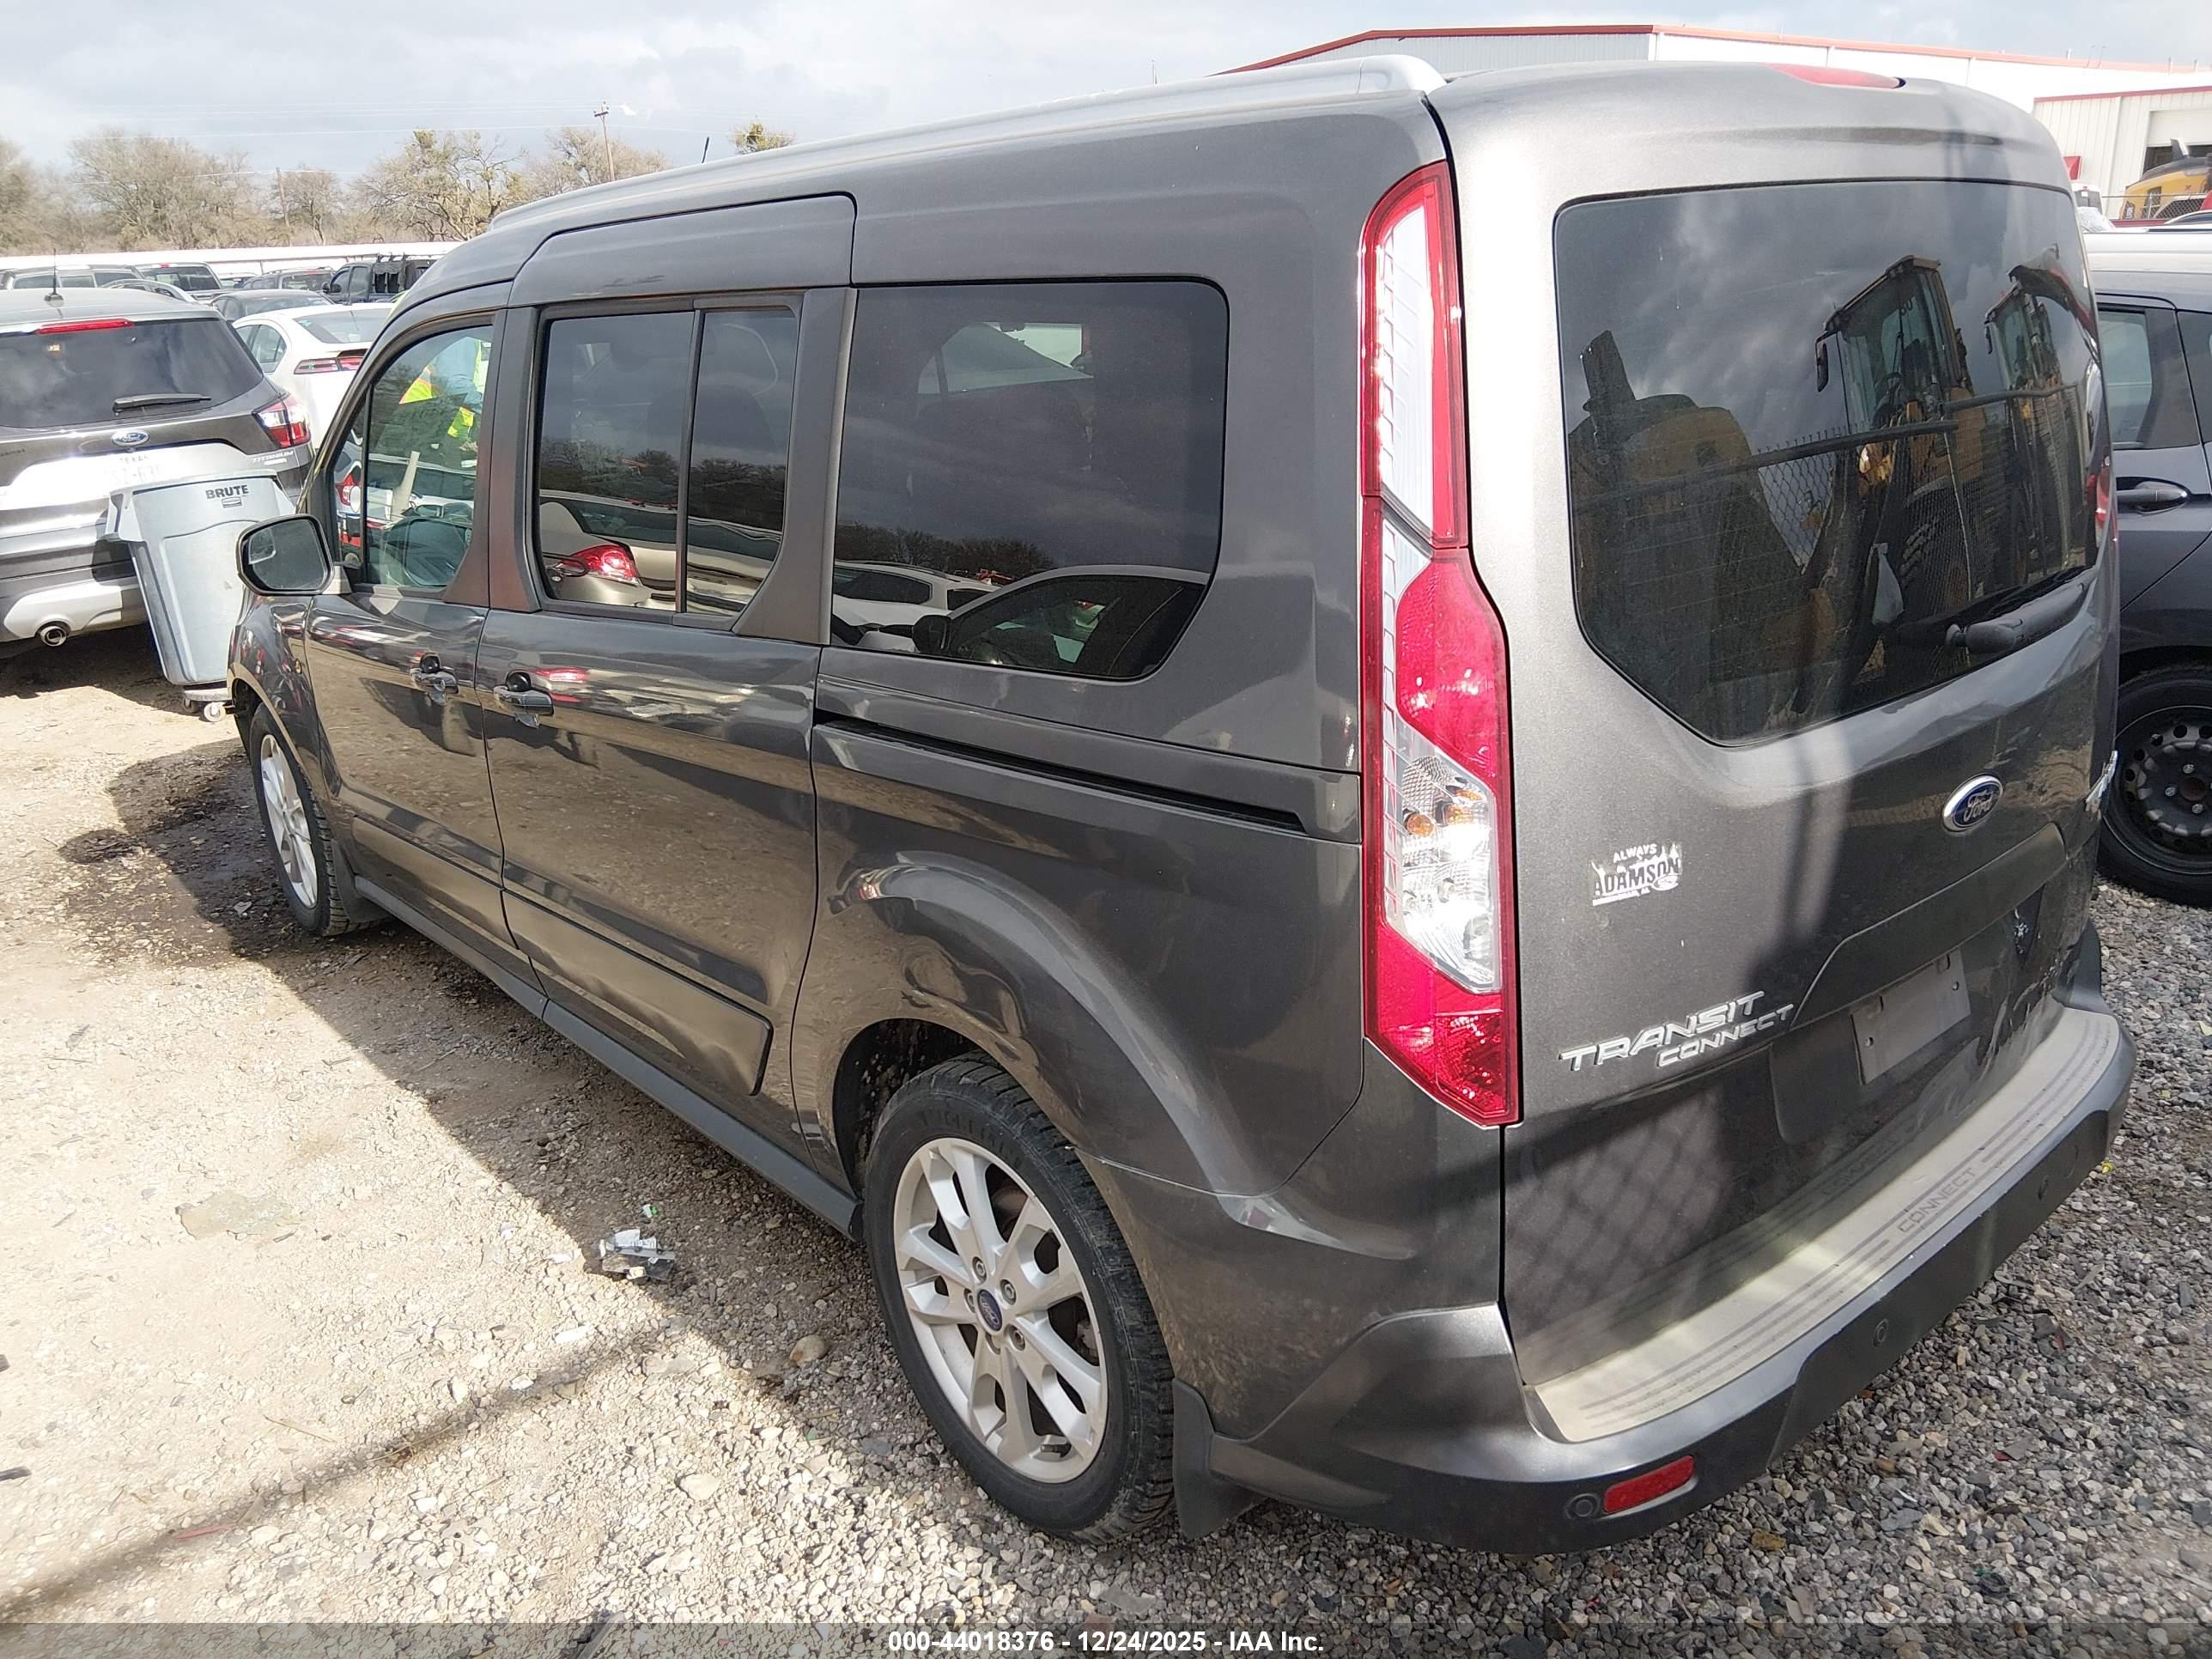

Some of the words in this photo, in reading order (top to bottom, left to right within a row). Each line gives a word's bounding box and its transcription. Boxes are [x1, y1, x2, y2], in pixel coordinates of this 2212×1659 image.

[205, 484, 249, 500] BRUTE
[1594, 859, 1680, 897] ADAMSON
[1613, 843, 1657, 863] ALWAYS
[1559, 990, 1765, 1072] TRANSIT
[1656, 1003, 1795, 1067] CONNECT
[1896, 1167, 1977, 1233] CONNECT
